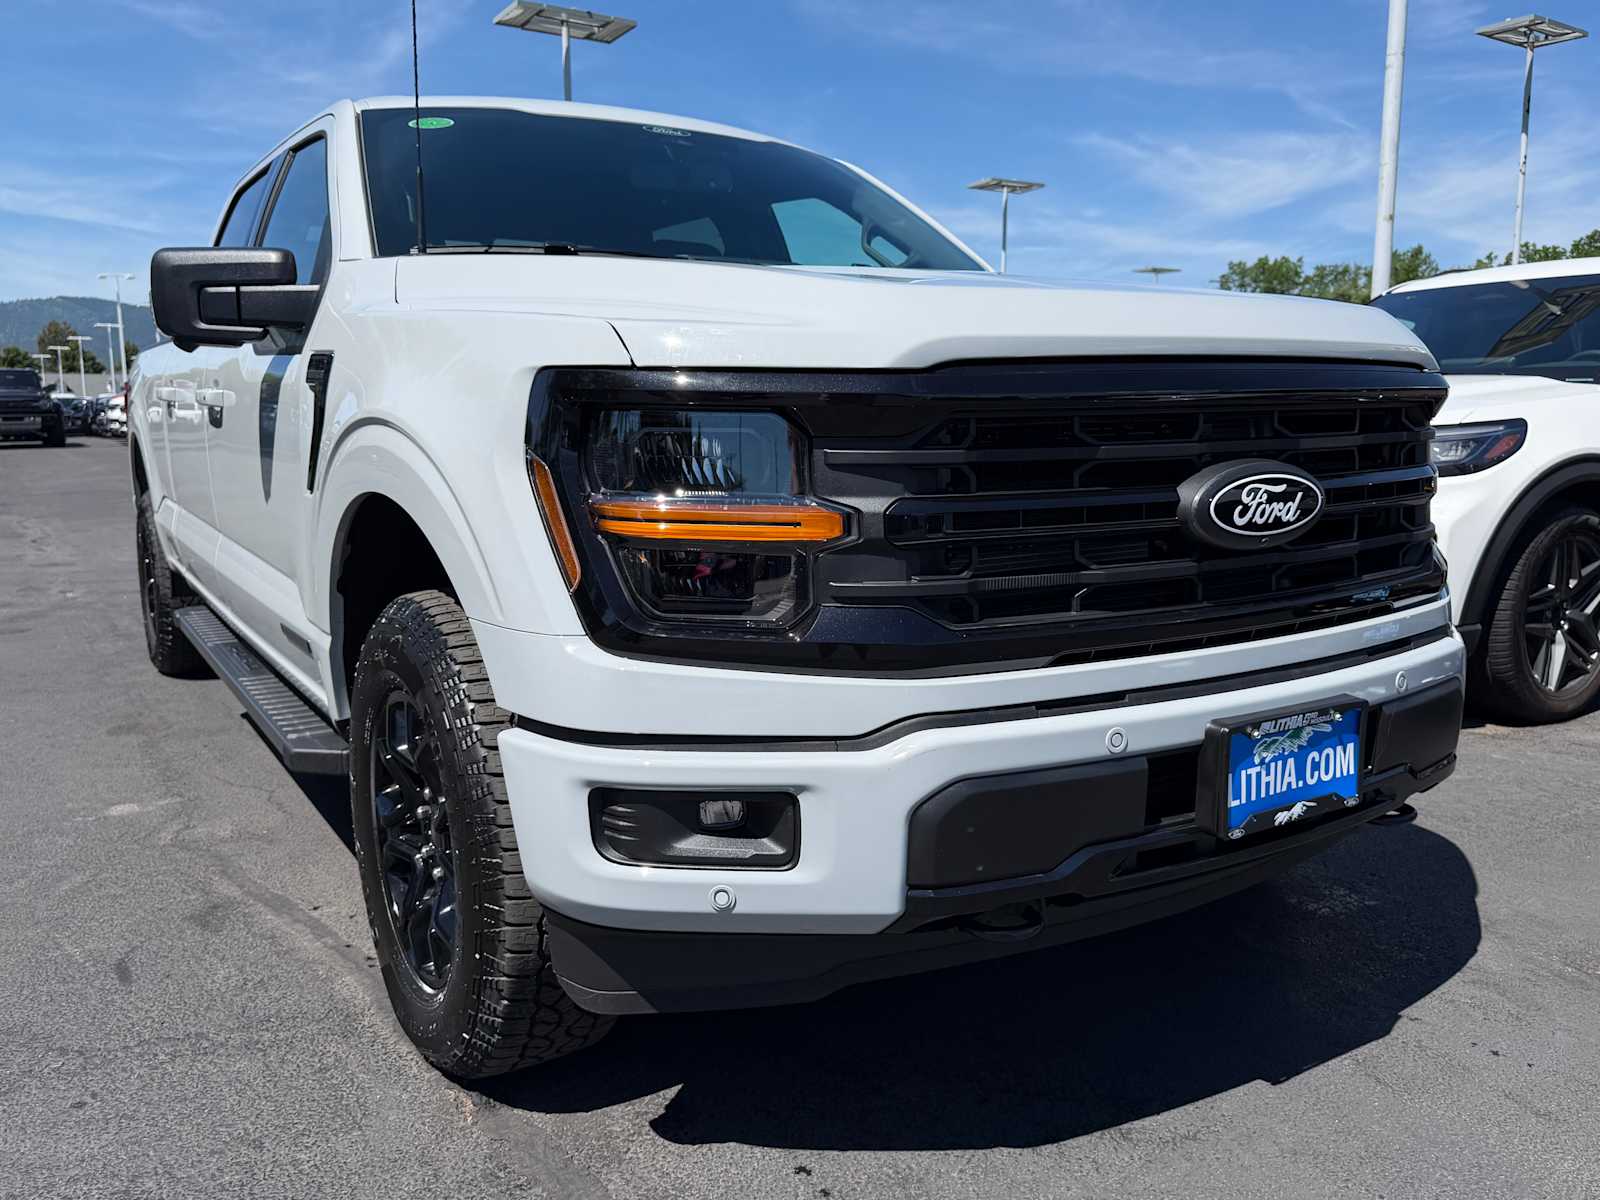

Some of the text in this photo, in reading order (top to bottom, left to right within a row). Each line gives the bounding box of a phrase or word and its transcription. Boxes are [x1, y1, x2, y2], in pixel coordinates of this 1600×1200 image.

[1233, 483, 1303, 526] Ford
[1270, 714, 1304, 733] LITHIA
[1228, 742, 1354, 808] LITHIA.COM
